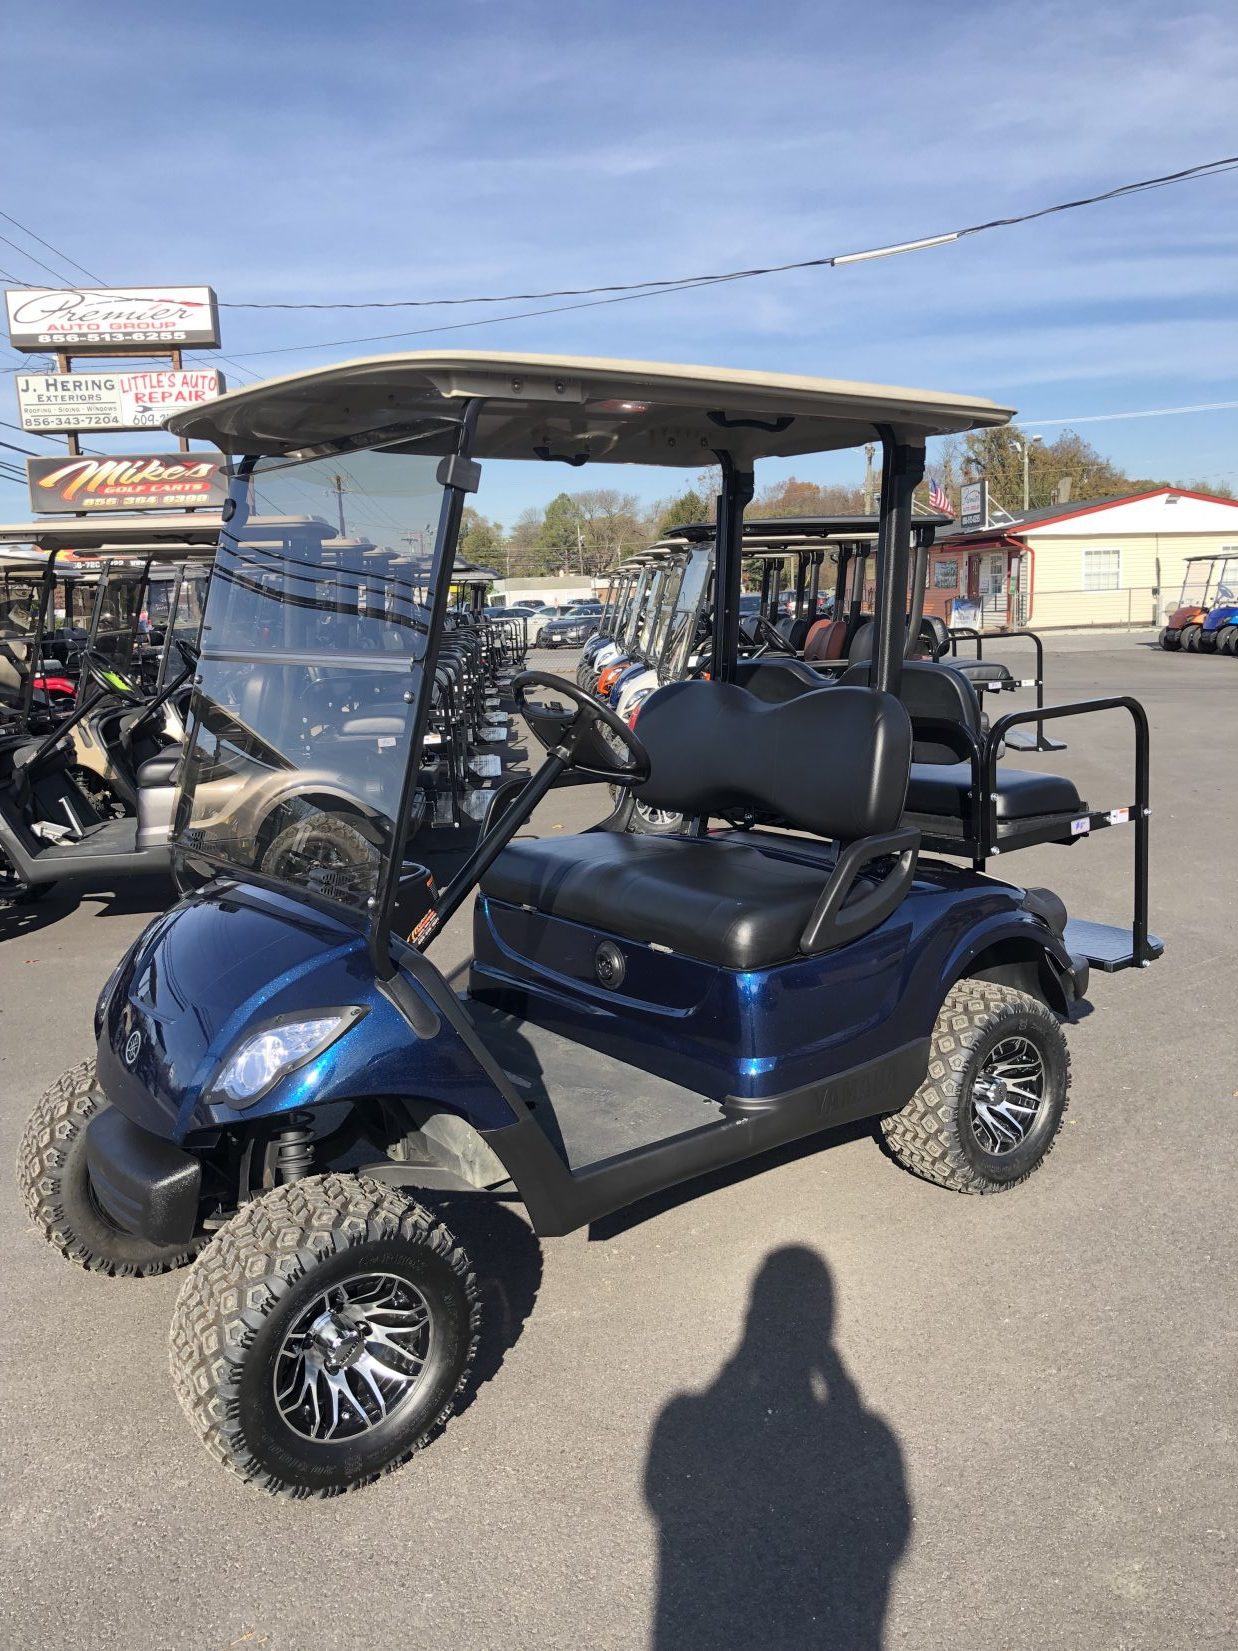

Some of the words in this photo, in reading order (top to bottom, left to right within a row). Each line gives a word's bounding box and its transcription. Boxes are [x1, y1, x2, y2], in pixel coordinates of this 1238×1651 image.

[14, 292, 193, 323] Premier
[47, 322, 100, 332] AUTO
[109, 321, 176, 331] GROUP
[38, 331, 187, 344] 856-513-6255
[20, 379, 37, 393] J.
[45, 378, 115, 392] HERING
[120, 374, 176, 394] LITTLE'S
[182, 374, 217, 391] AUTO
[37, 393, 102, 403] EXTERIORS
[134, 390, 206, 404] REPAIR
[24, 416, 120, 427] 856-343-7204
[103, 485, 145, 494] GOLF
[149, 483, 204, 493] CARTS
